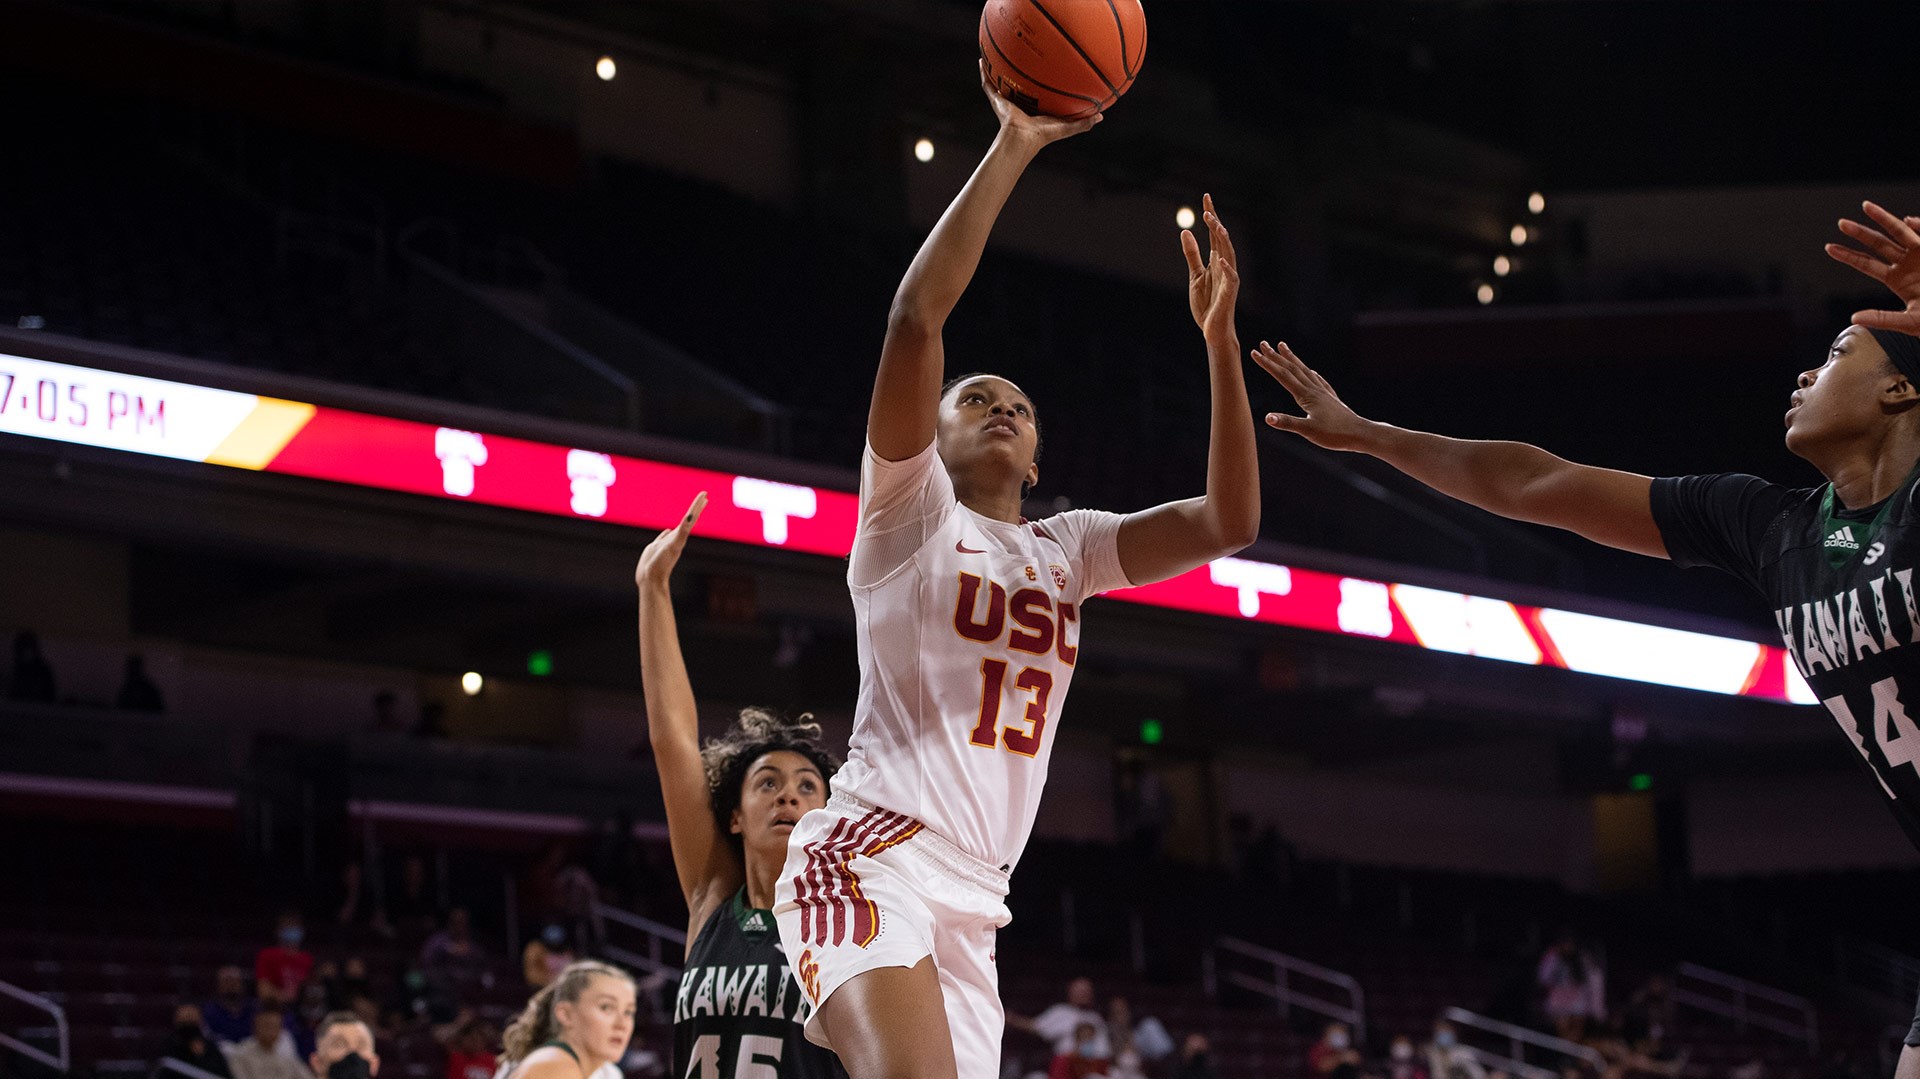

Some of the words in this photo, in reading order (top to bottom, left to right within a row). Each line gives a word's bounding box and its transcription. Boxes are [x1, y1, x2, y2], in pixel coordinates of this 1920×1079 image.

[108, 390, 165, 438] PM
[1823, 539, 1860, 550] adidas
[953, 570, 1078, 668] USC
[969, 656, 1053, 759] 13
